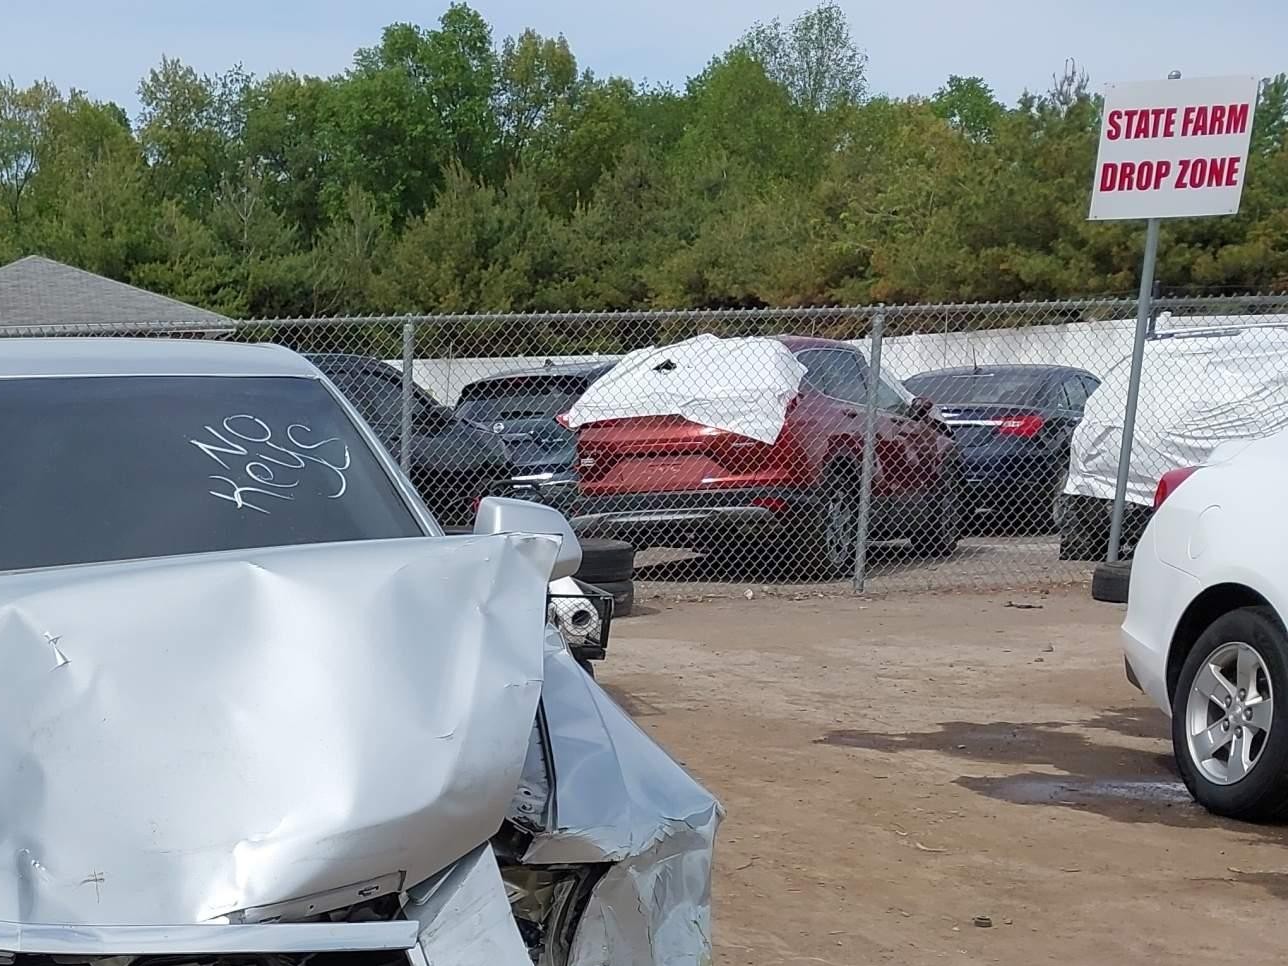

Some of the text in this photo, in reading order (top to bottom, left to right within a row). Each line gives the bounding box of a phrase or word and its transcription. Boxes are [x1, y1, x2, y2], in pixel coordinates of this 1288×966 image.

[1106, 103, 1250, 141] STATE FARM
[1099, 156, 1241, 192] DROP ZONE
[189, 414, 272, 470] NO
